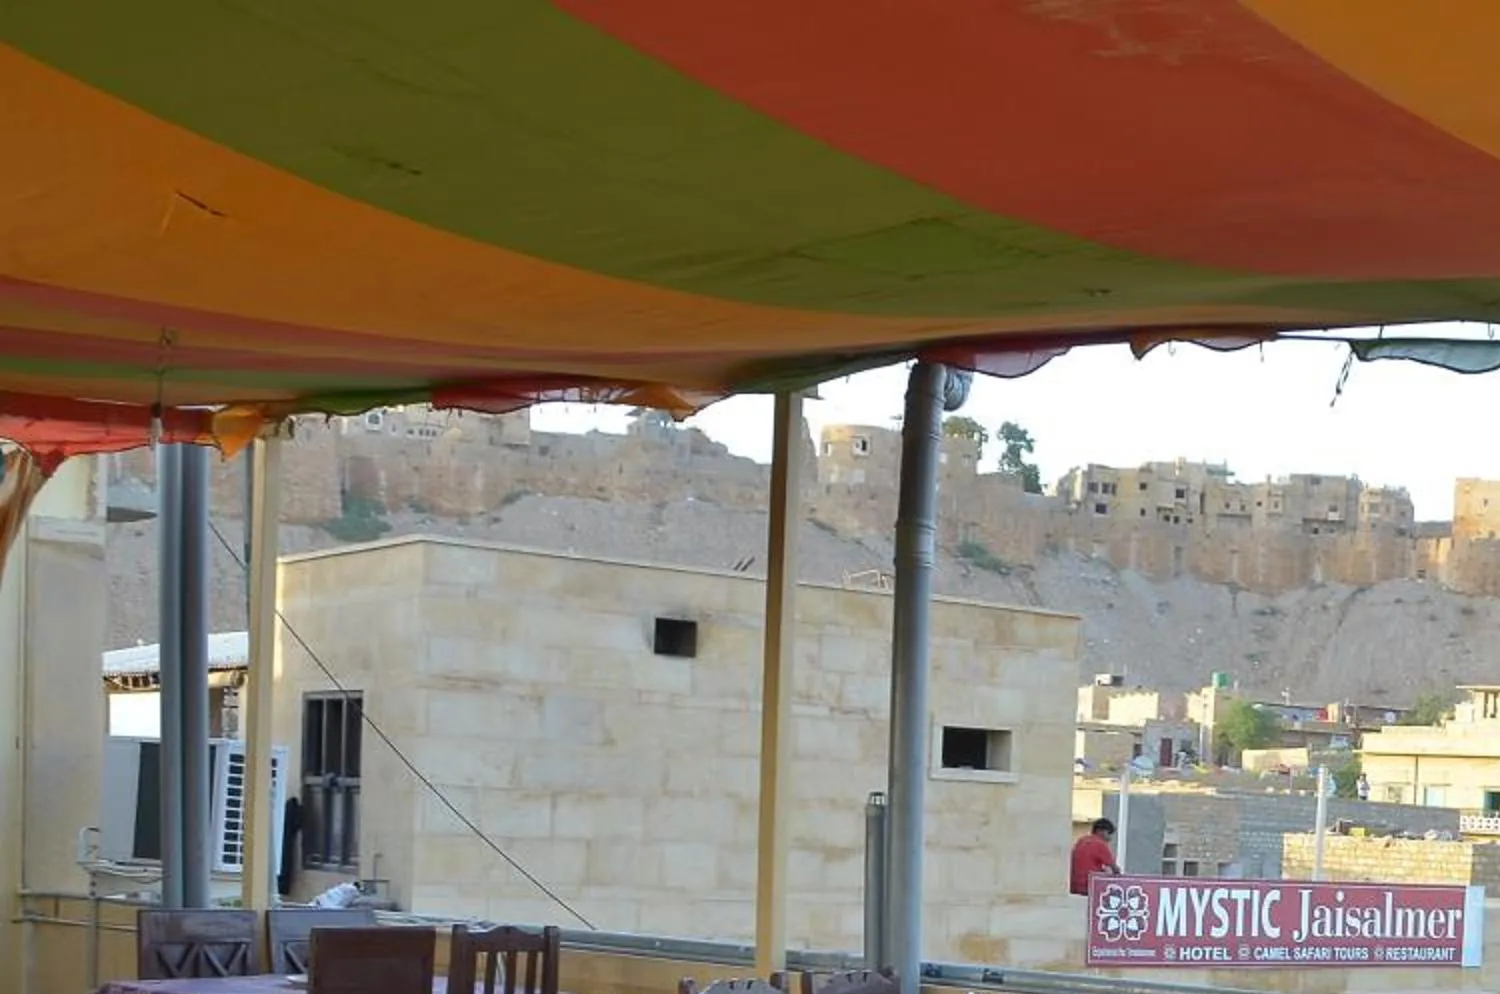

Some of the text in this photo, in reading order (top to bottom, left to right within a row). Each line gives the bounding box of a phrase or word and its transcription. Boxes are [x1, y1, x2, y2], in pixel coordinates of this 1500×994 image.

[1155, 887, 1463, 943] MYSTIC Jaisalmer
[1179, 946, 1456, 961] HOTEL CAMEL SAFARI TOURS RESTAURANT
